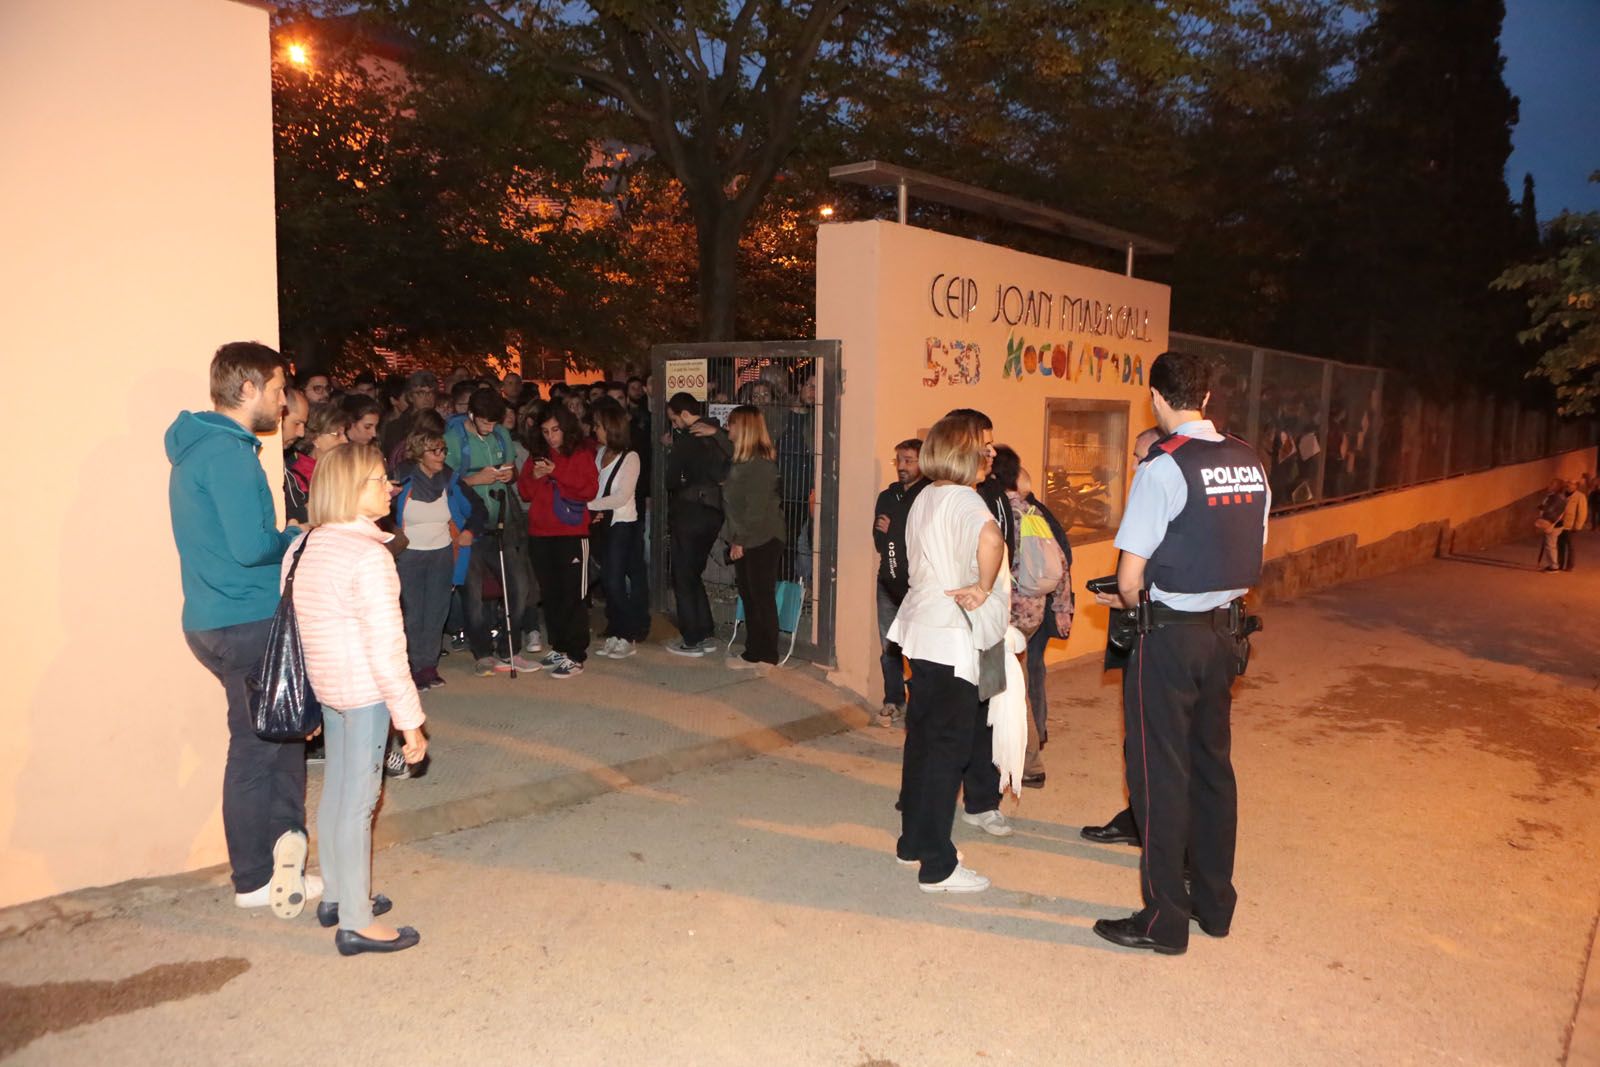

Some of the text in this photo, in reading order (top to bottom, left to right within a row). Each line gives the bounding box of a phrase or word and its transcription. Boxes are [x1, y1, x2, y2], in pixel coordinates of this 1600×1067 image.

[931, 273, 1152, 342] CEIP JOAN MARAGALL
[1200, 466, 1263, 486] POLICIA
